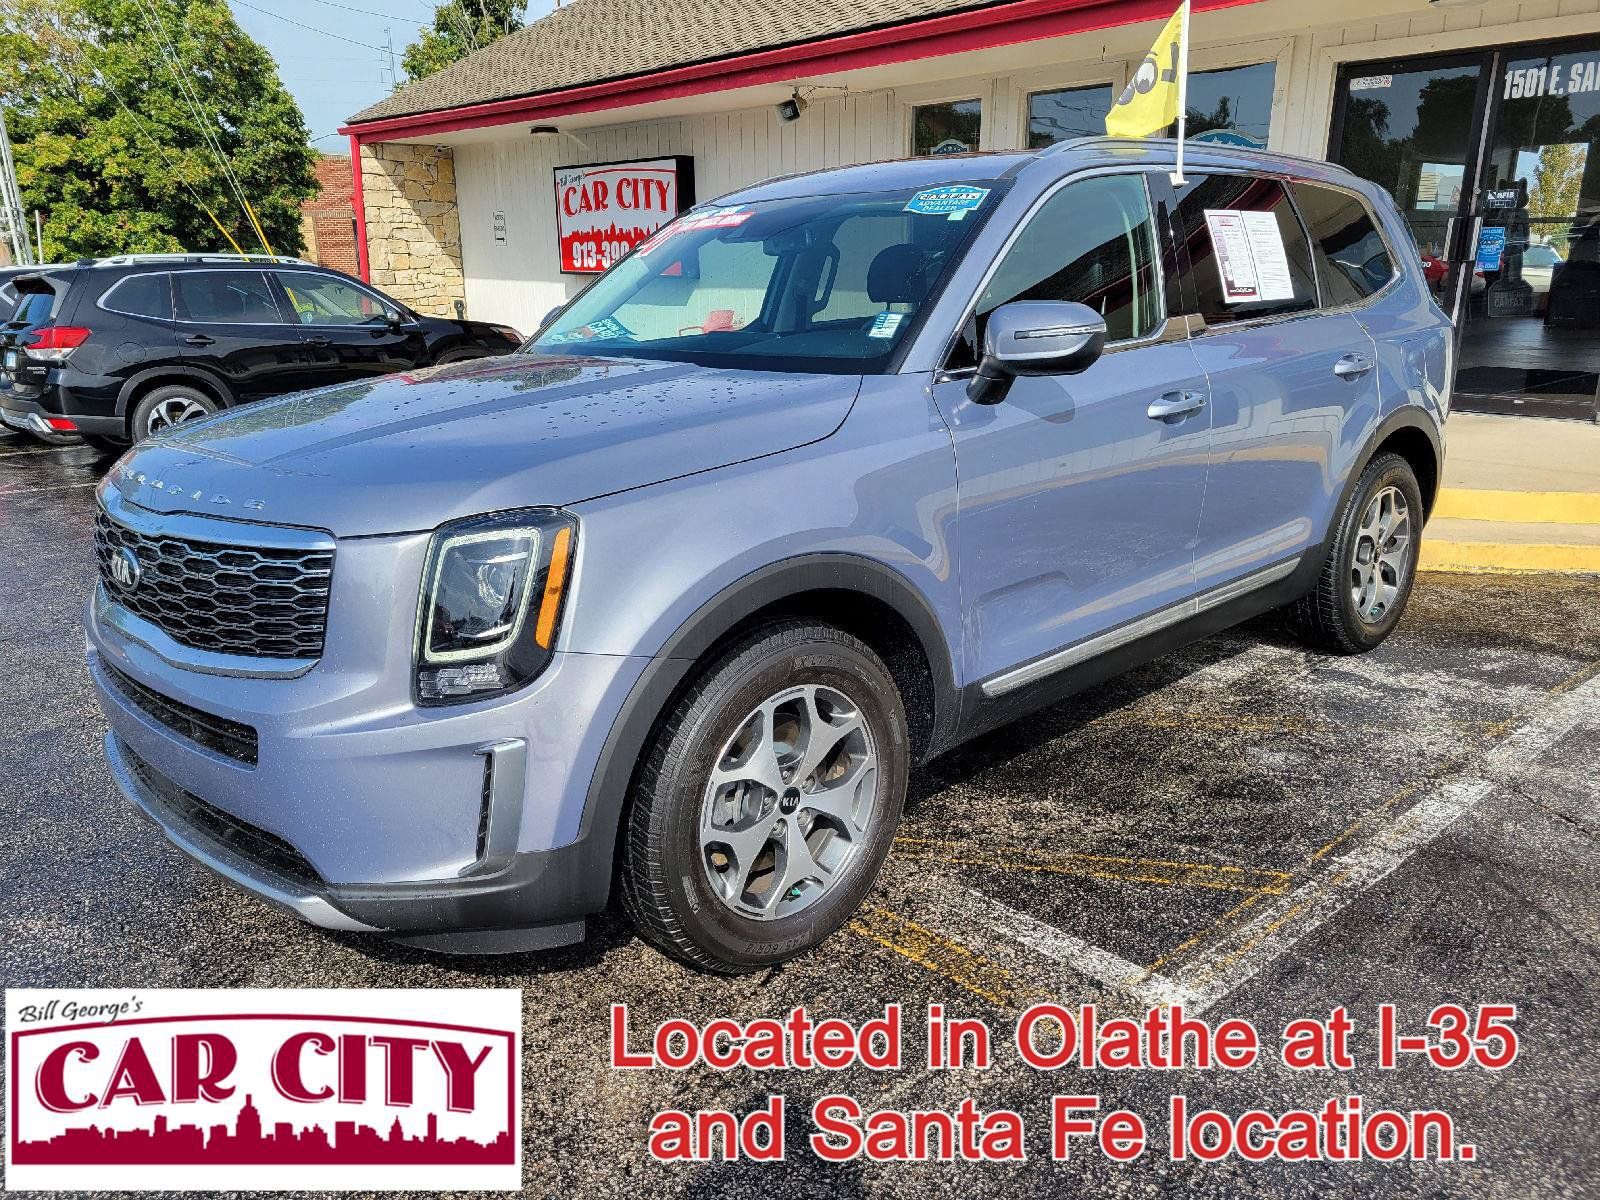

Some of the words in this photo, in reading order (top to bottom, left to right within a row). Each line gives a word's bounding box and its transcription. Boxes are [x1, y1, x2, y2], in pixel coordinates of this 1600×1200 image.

[1503, 66, 1548, 100] 1501
[1548, 65, 1564, 96] E.
[563, 181, 609, 217] CAR
[616, 178, 671, 213] CITY
[782, 796, 799, 807] KIA
